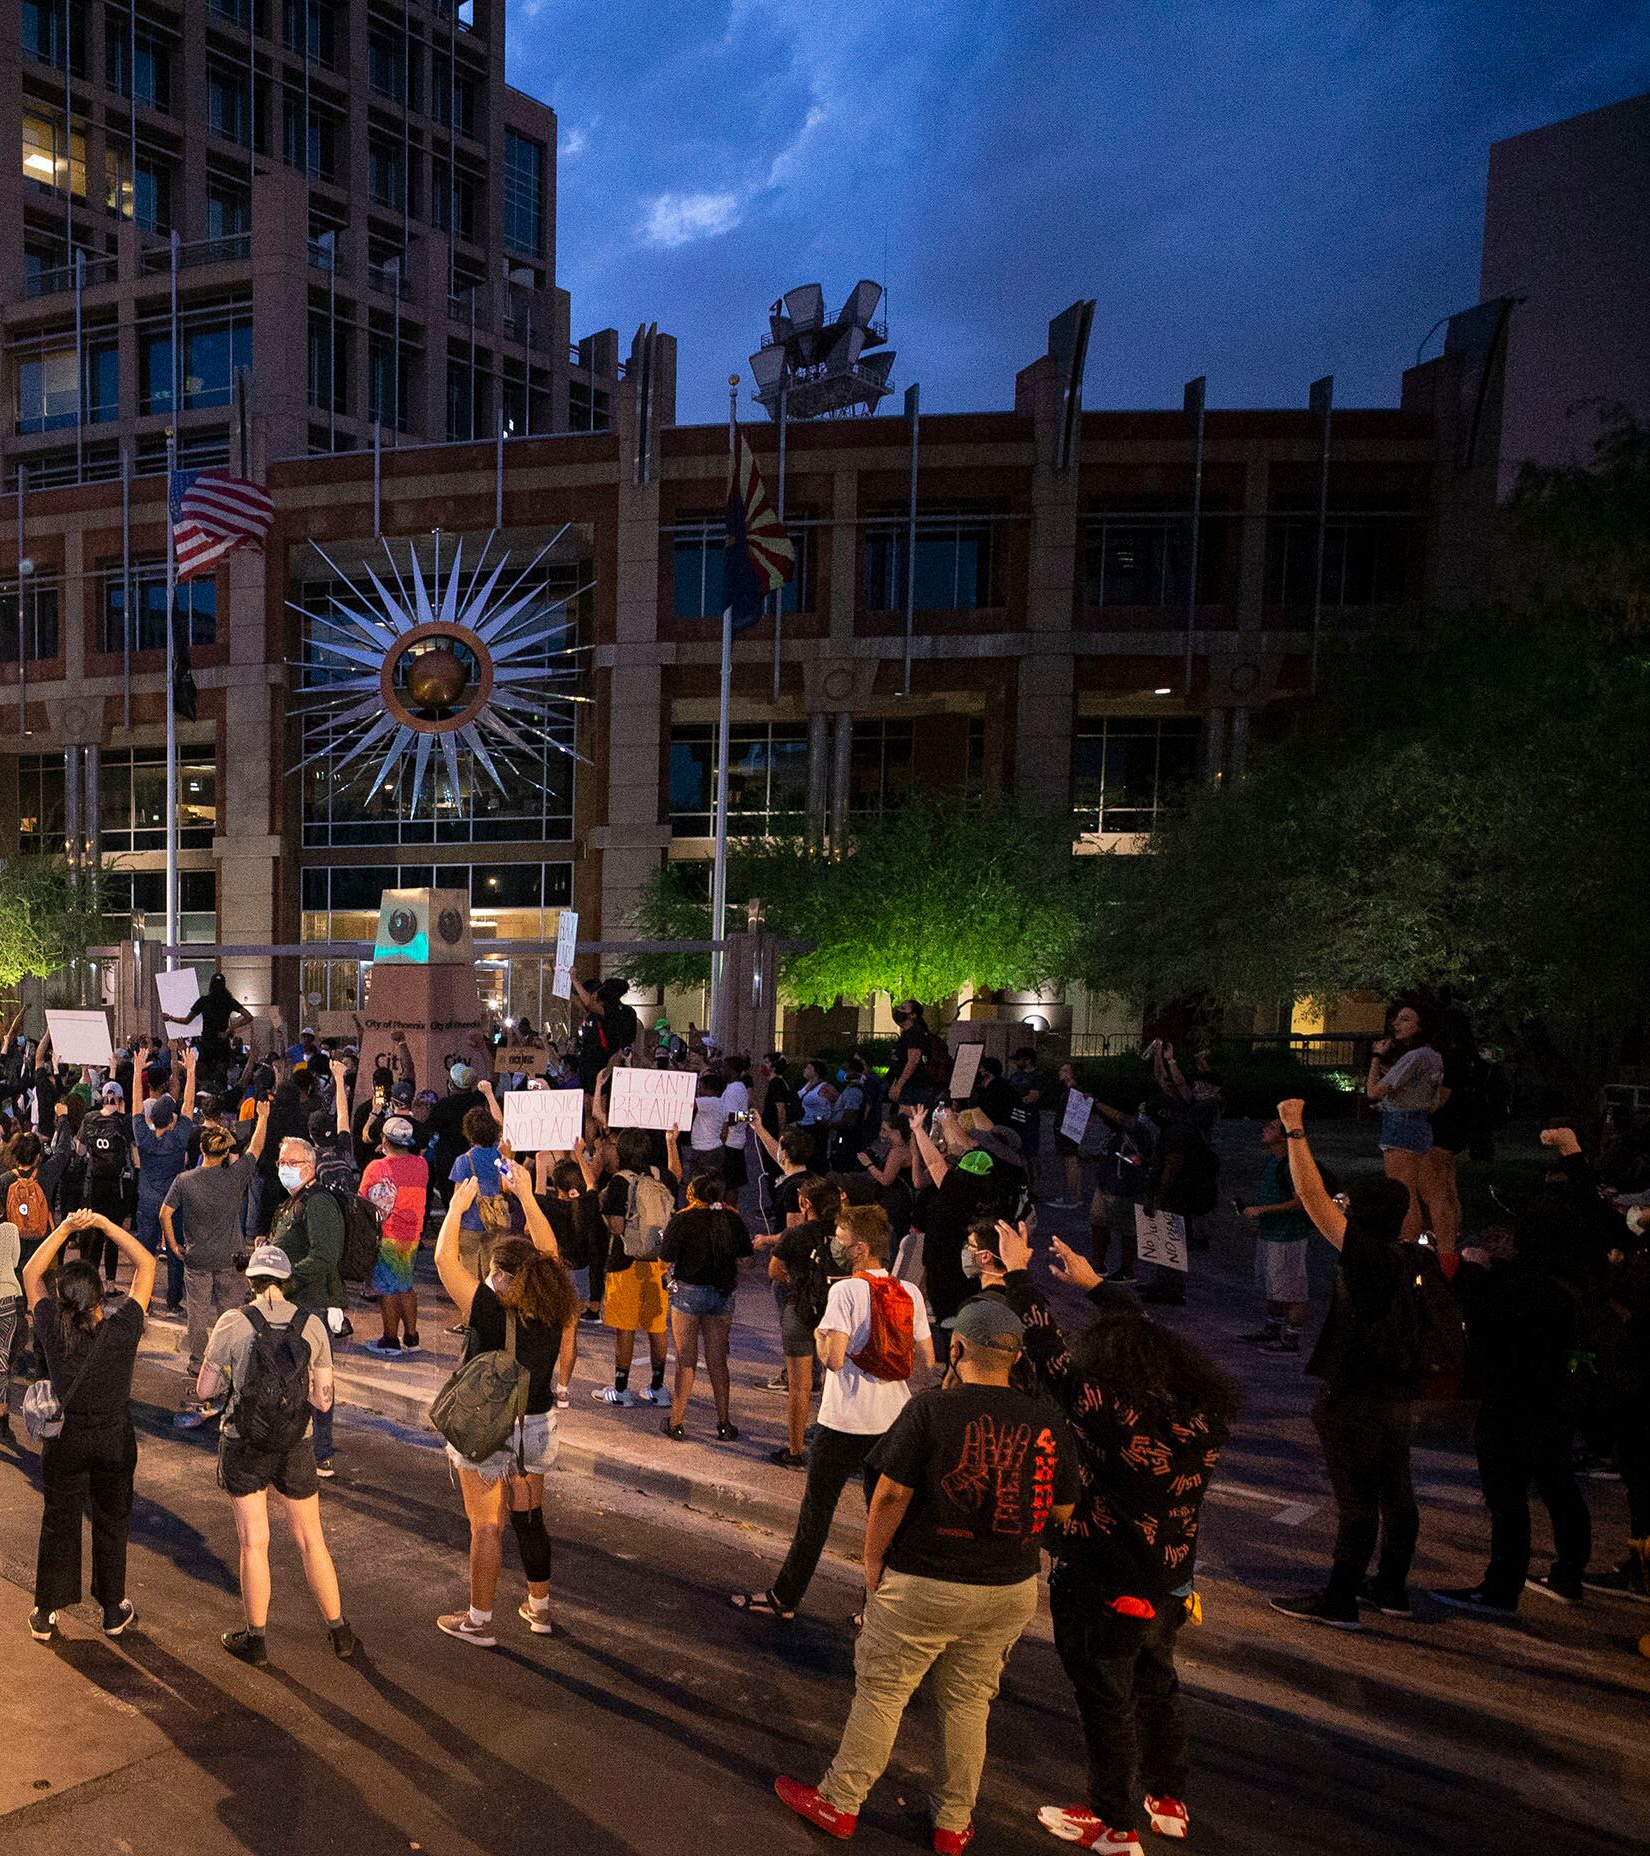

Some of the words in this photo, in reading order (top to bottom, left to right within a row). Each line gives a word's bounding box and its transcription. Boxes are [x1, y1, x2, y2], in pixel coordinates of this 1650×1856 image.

[365, 1020, 380, 1030] City
[383, 1020, 392, 1029] of
[393, 1020, 426, 1030] Phoenix
[644, 1072, 693, 1097] CAN'T
[507, 1094, 531, 1114] NO
[612, 1096, 691, 1127] BREATHE
[506, 1121, 528, 1146] NO
